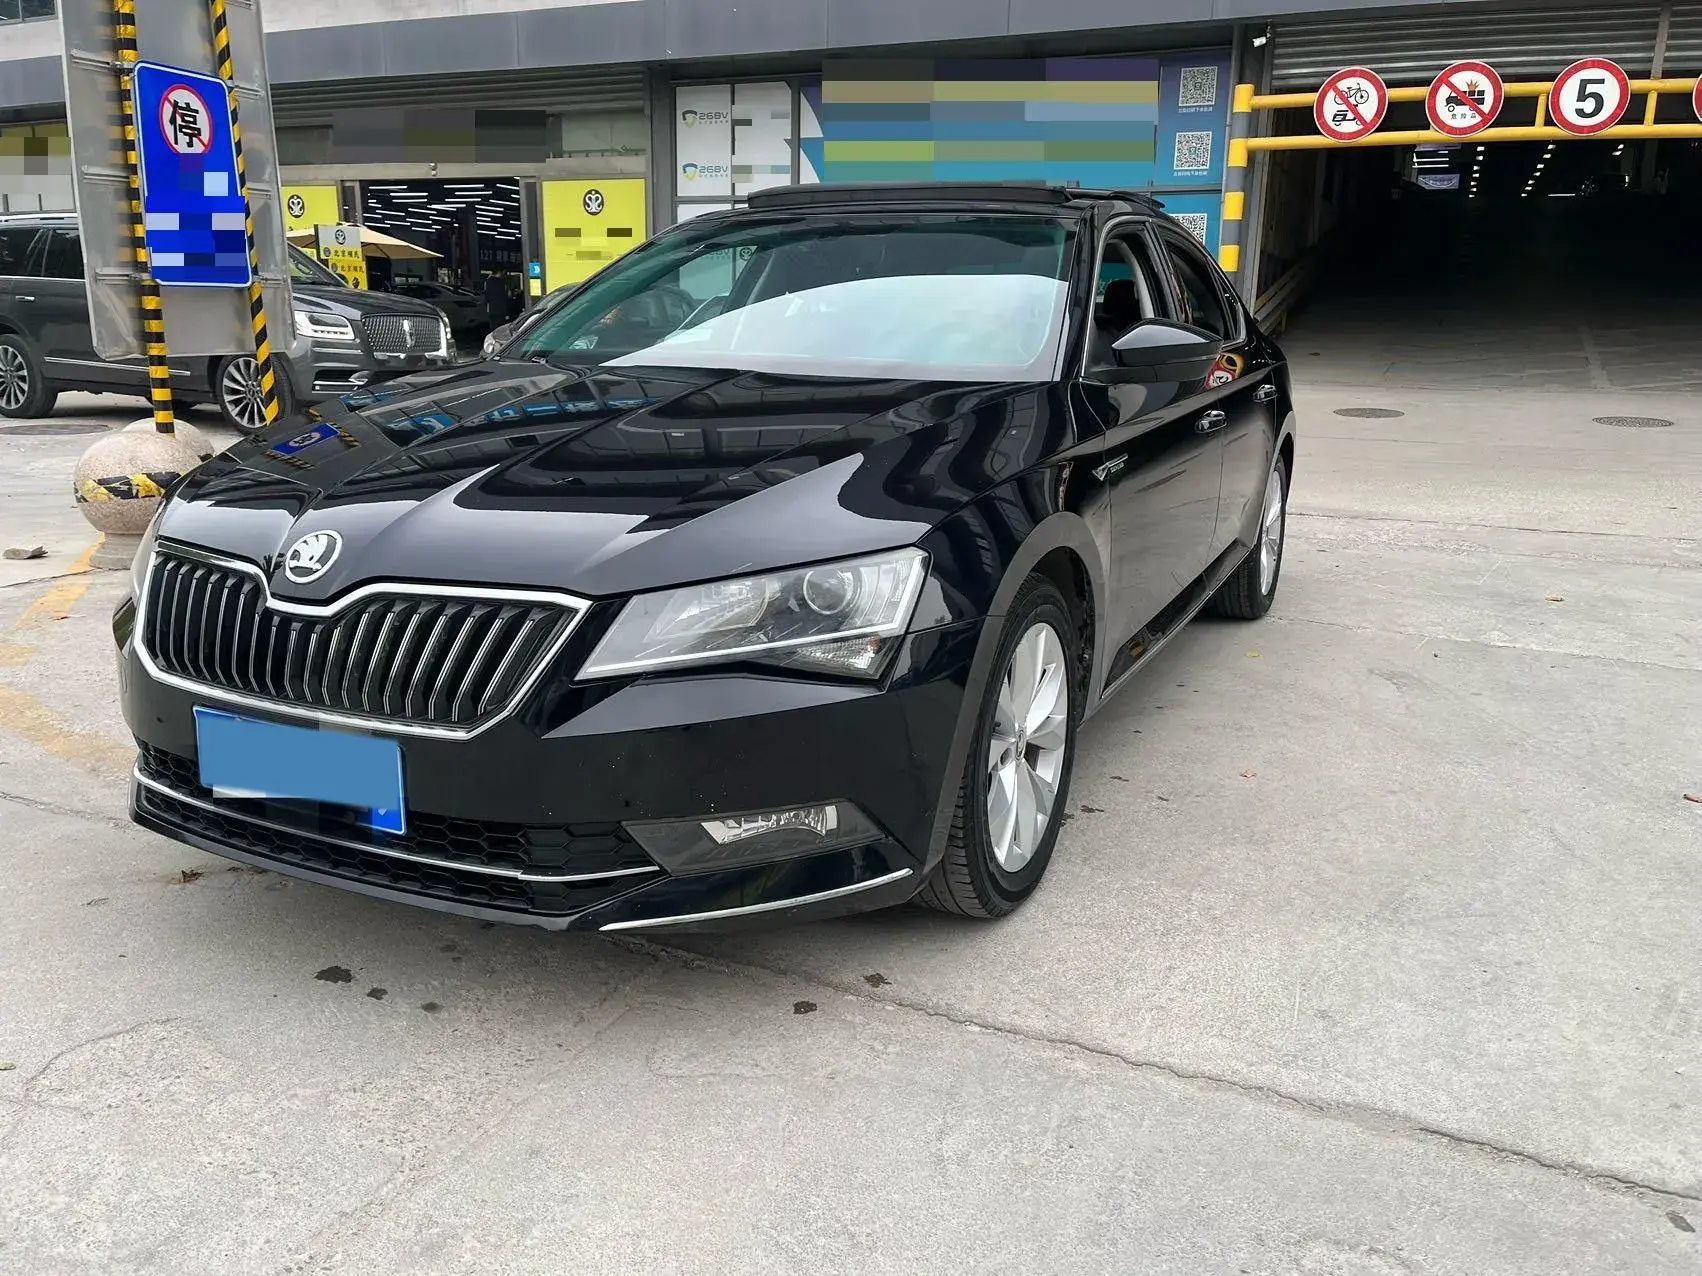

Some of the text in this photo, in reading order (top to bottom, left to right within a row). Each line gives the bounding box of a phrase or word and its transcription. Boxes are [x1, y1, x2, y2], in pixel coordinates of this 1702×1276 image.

[1574, 78, 1605, 119] 5
[169, 99, 201, 148] 停
[699, 111, 729, 120] 268V
[699, 165, 729, 174] 268V
